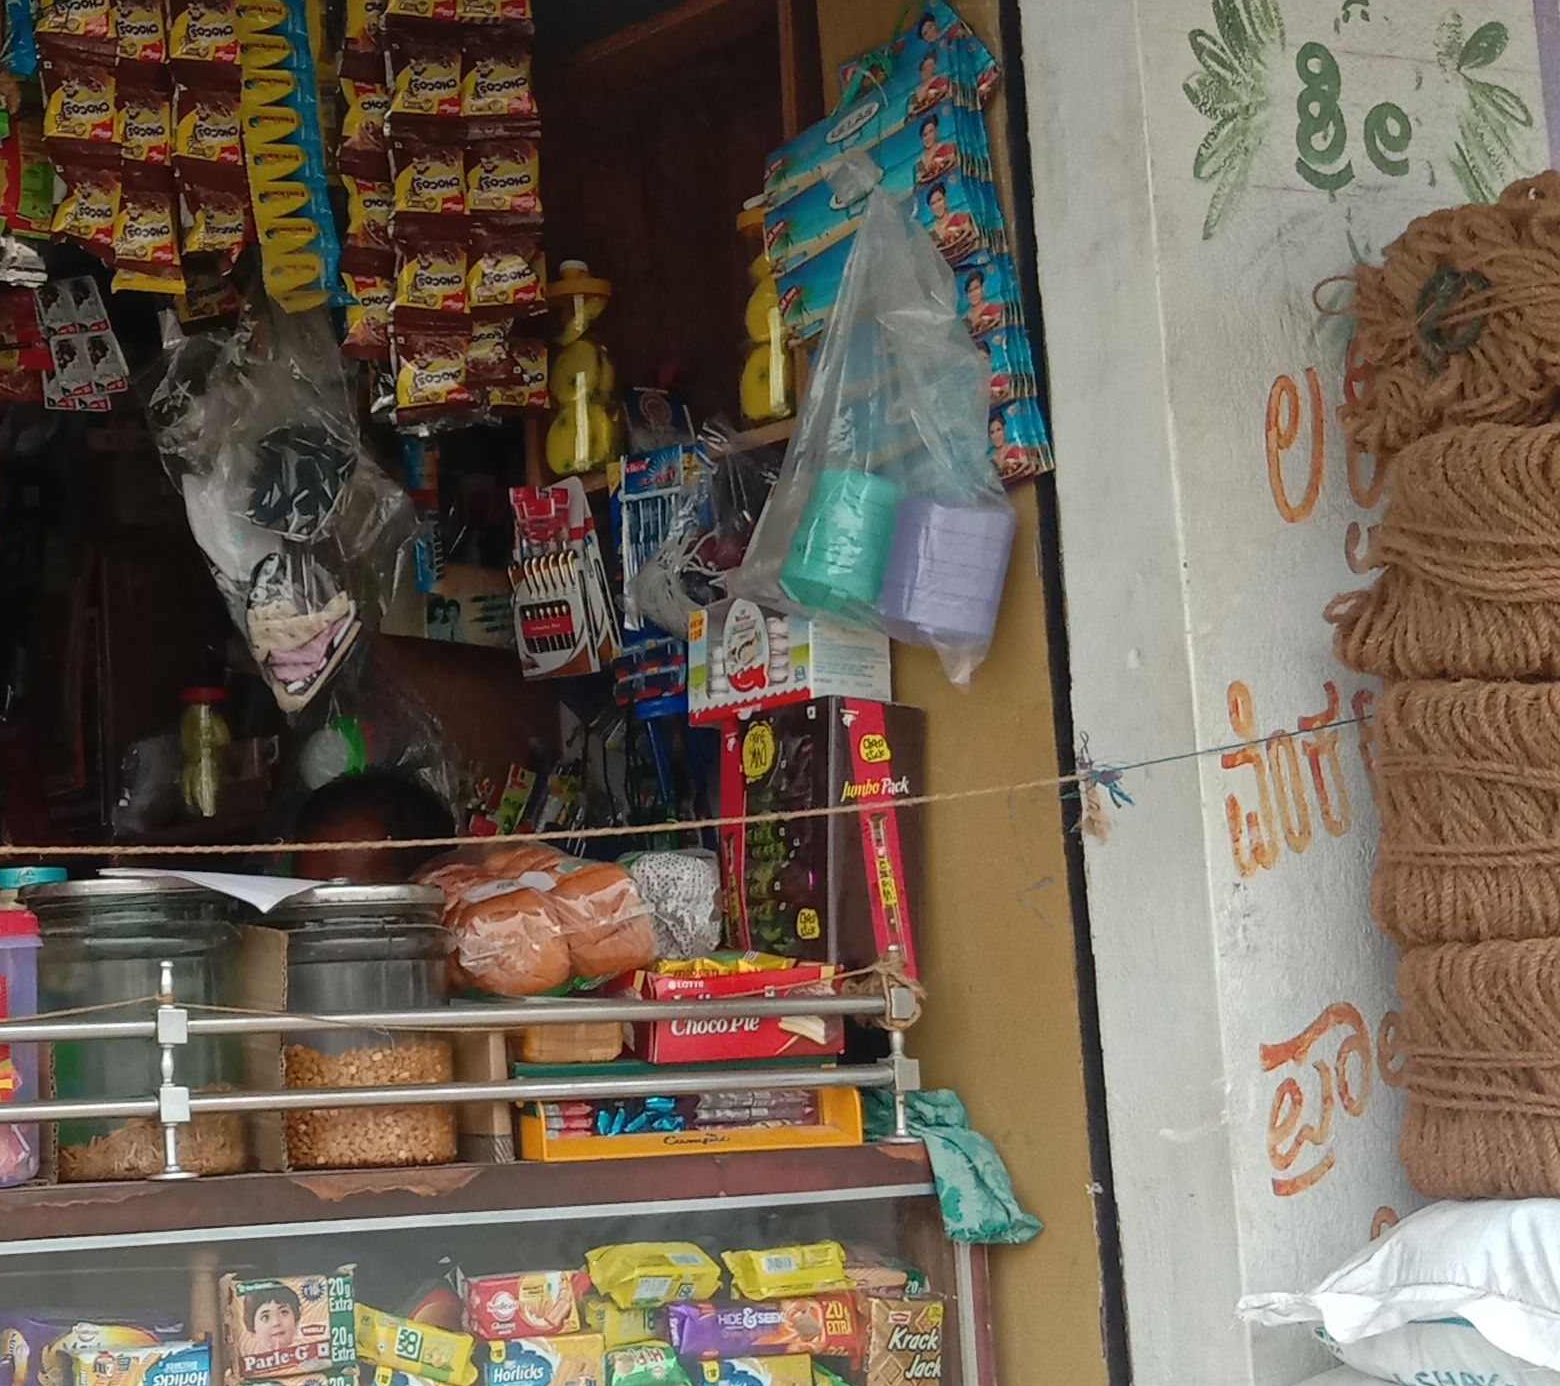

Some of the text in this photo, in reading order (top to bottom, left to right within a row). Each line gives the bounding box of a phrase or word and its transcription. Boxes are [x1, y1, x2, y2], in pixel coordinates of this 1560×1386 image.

[841, 775, 910, 801] Jumbo Pack
[329, 1295, 355, 1311] Extra
[887, 1328, 938, 1351] Krack
[241, 1346, 309, 1372] Parle-G
[493, 1361, 545, 1384] Horlicks
